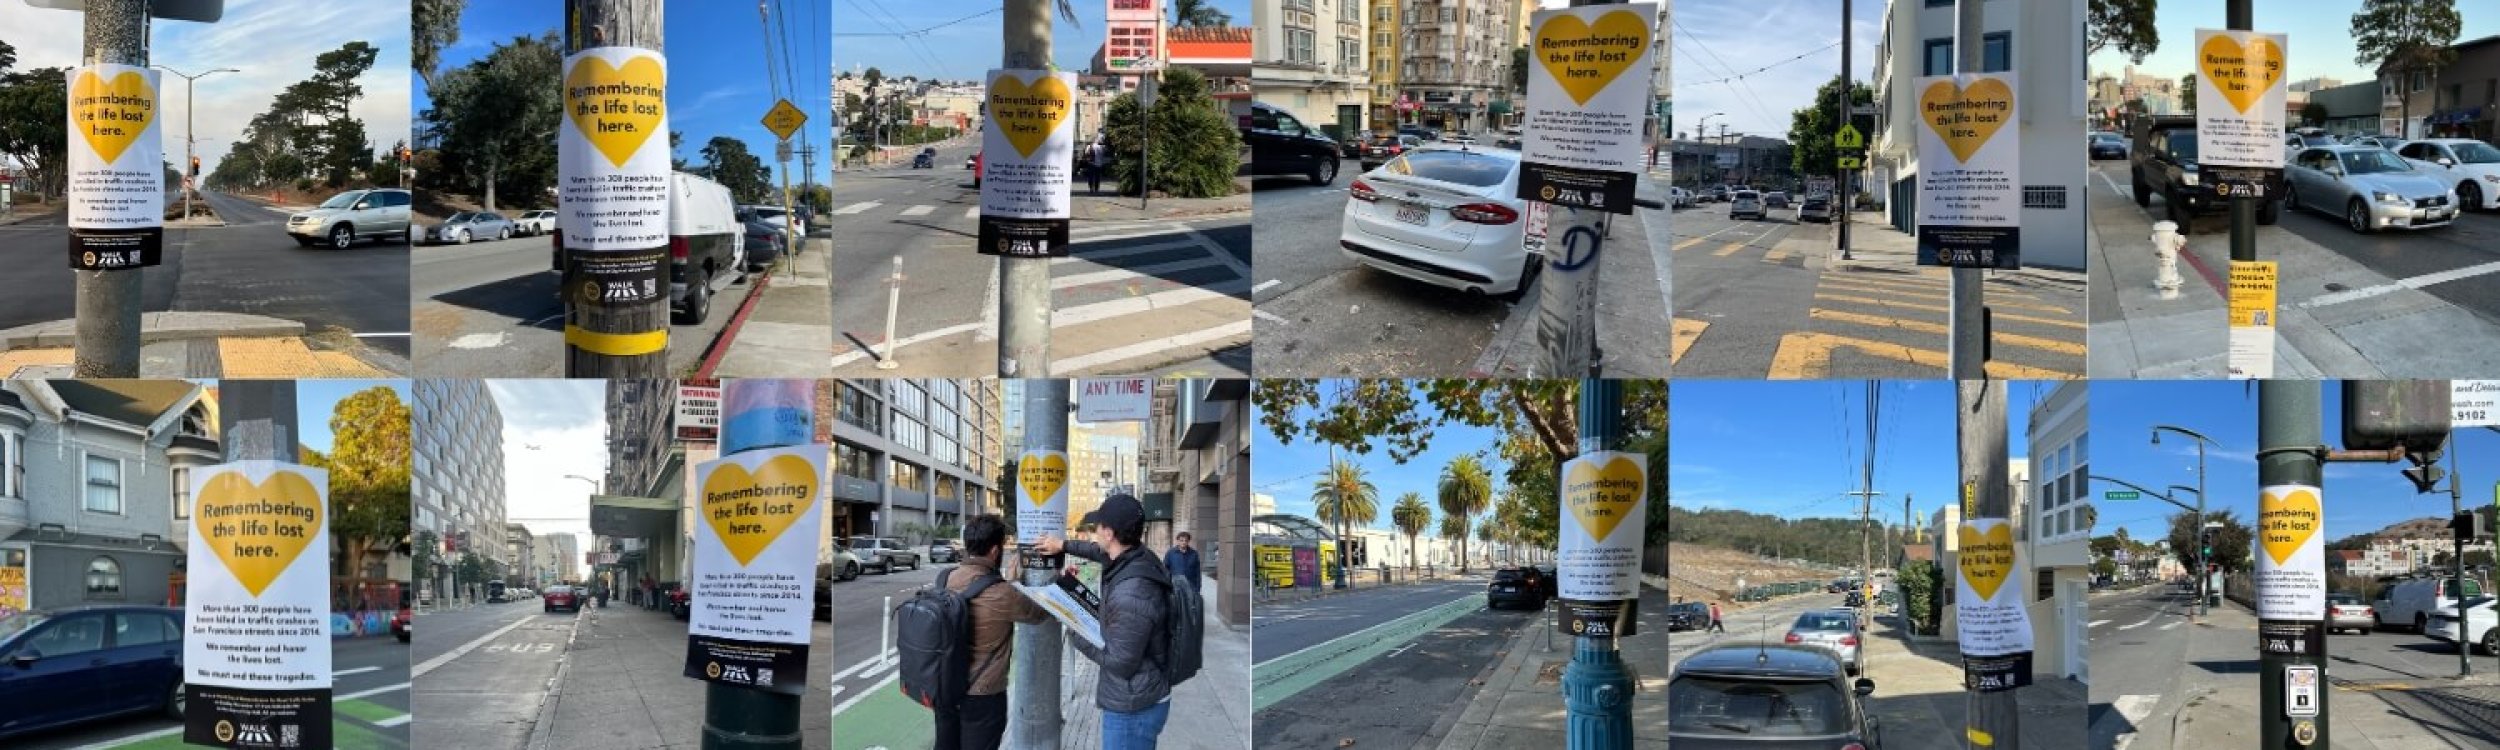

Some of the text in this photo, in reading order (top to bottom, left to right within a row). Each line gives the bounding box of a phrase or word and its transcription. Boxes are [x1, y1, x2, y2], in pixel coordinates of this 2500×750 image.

[1542, 34, 1639, 49] Remembering
[1550, 50, 1626, 63] the life lost
[2206, 54, 2279, 70] Rememng
[1567, 66, 1601, 78] here.
[2214, 68, 2248, 78] the lif
[577, 98, 658, 115] the life lost
[993, 94, 1064, 110] Remembering
[1927, 98, 2007, 112] Remembering
[98, 108, 117, 120] life
[121, 108, 144, 122] lost
[999, 107, 1013, 118] the
[1038, 110, 1057, 120] lost
[1936, 112, 1998, 125] the life lost
[93, 124, 125, 135] here.
[597, 118, 638, 132] here.
[1012, 122, 1040, 133] here.
[1950, 128, 1978, 138] here.
[1086, 379, 1144, 395] ANY TIME
[2455, 383, 2472, 392] and
[707, 483, 807, 505] Remembering
[1590, 492, 1608, 502] life
[204, 499, 314, 522] Remembering
[714, 501, 794, 520] the life lost
[213, 520, 304, 537] the life lost
[729, 521, 767, 535] here.
[2272, 520, 2287, 530] life
[2291, 520, 2310, 530] lost
[2268, 533, 2294, 542] here.
[234, 542, 279, 557] here.
[243, 605, 259, 613] 300
[261, 606, 291, 615] people
[293, 605, 312, 613] have
[248, 615, 274, 624] traffic
[276, 616, 306, 625] crashes
[245, 627, 274, 635] streets
[277, 627, 298, 635] since
[265, 644, 280, 652] and
[283, 644, 307, 652] honor
[228, 654, 240, 662] the
[265, 655, 283, 663] lost.
[233, 672, 247, 680] end
[249, 672, 272, 680] these
[275, 672, 316, 683] tragedies.
[240, 722, 267, 732] WALK
